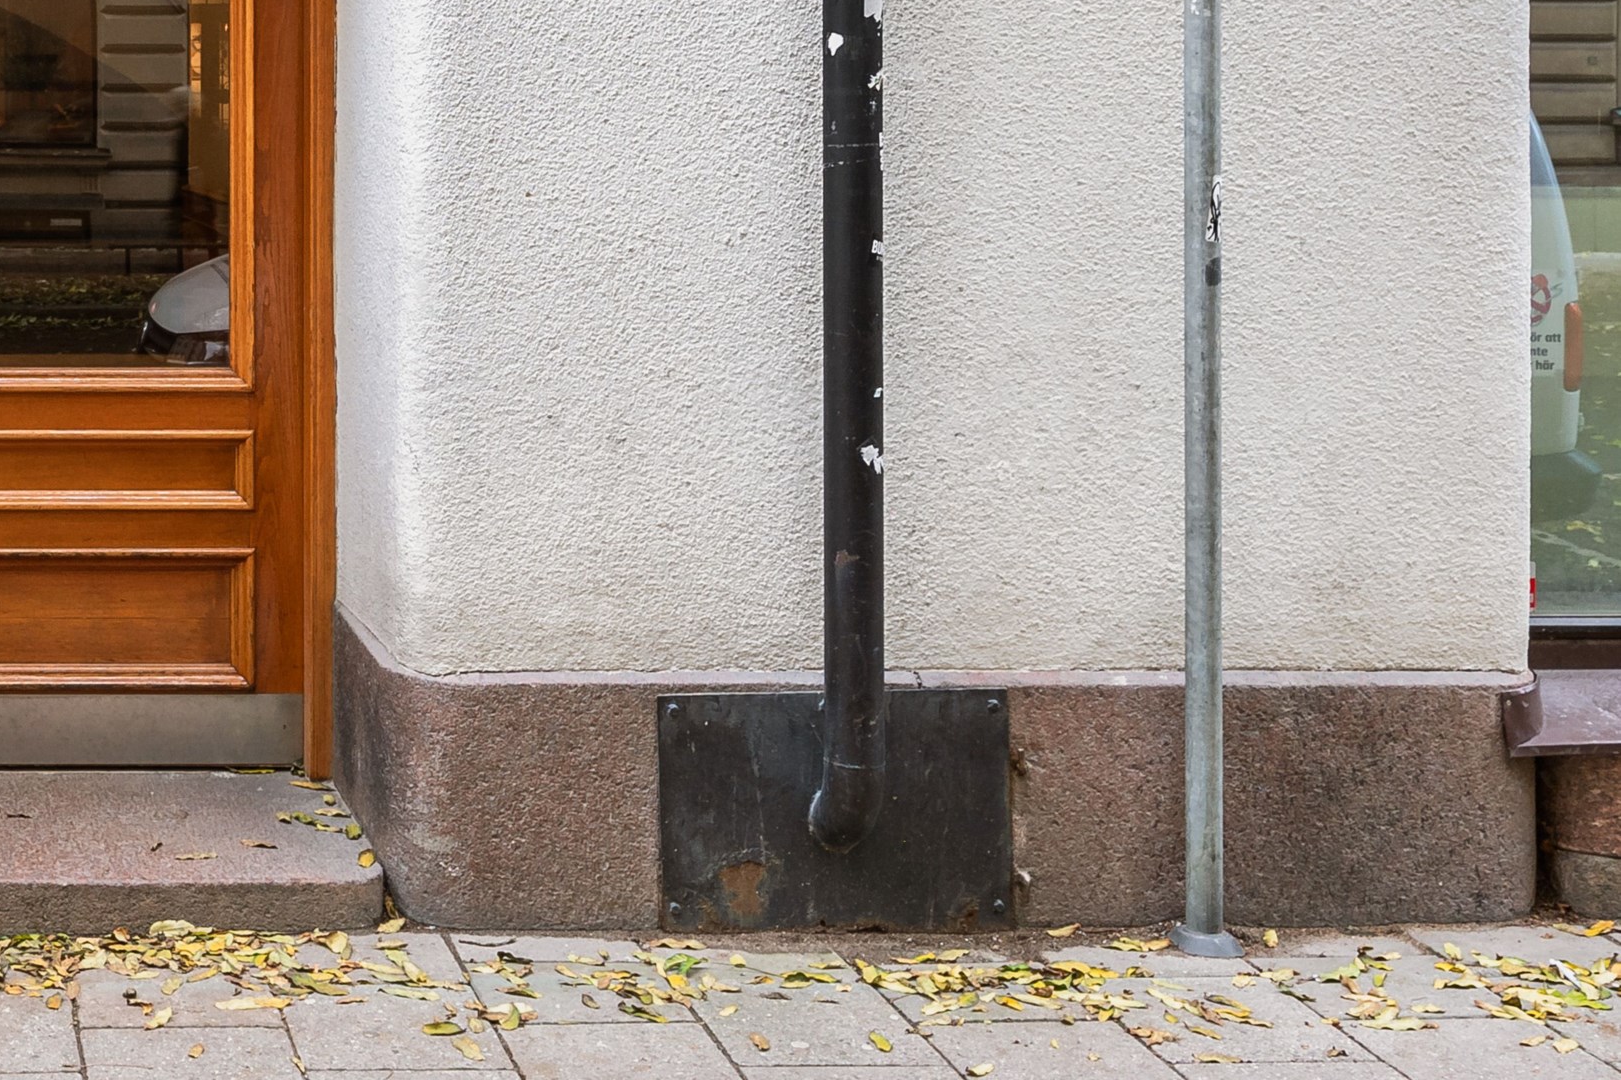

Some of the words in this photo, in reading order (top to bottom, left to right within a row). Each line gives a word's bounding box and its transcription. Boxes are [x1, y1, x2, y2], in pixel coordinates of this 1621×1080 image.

[1530, 331, 1542, 343] ör
[1545, 333, 1561, 343] att
[1530, 347, 1548, 357] nte
[1535, 360, 1554, 370] här
